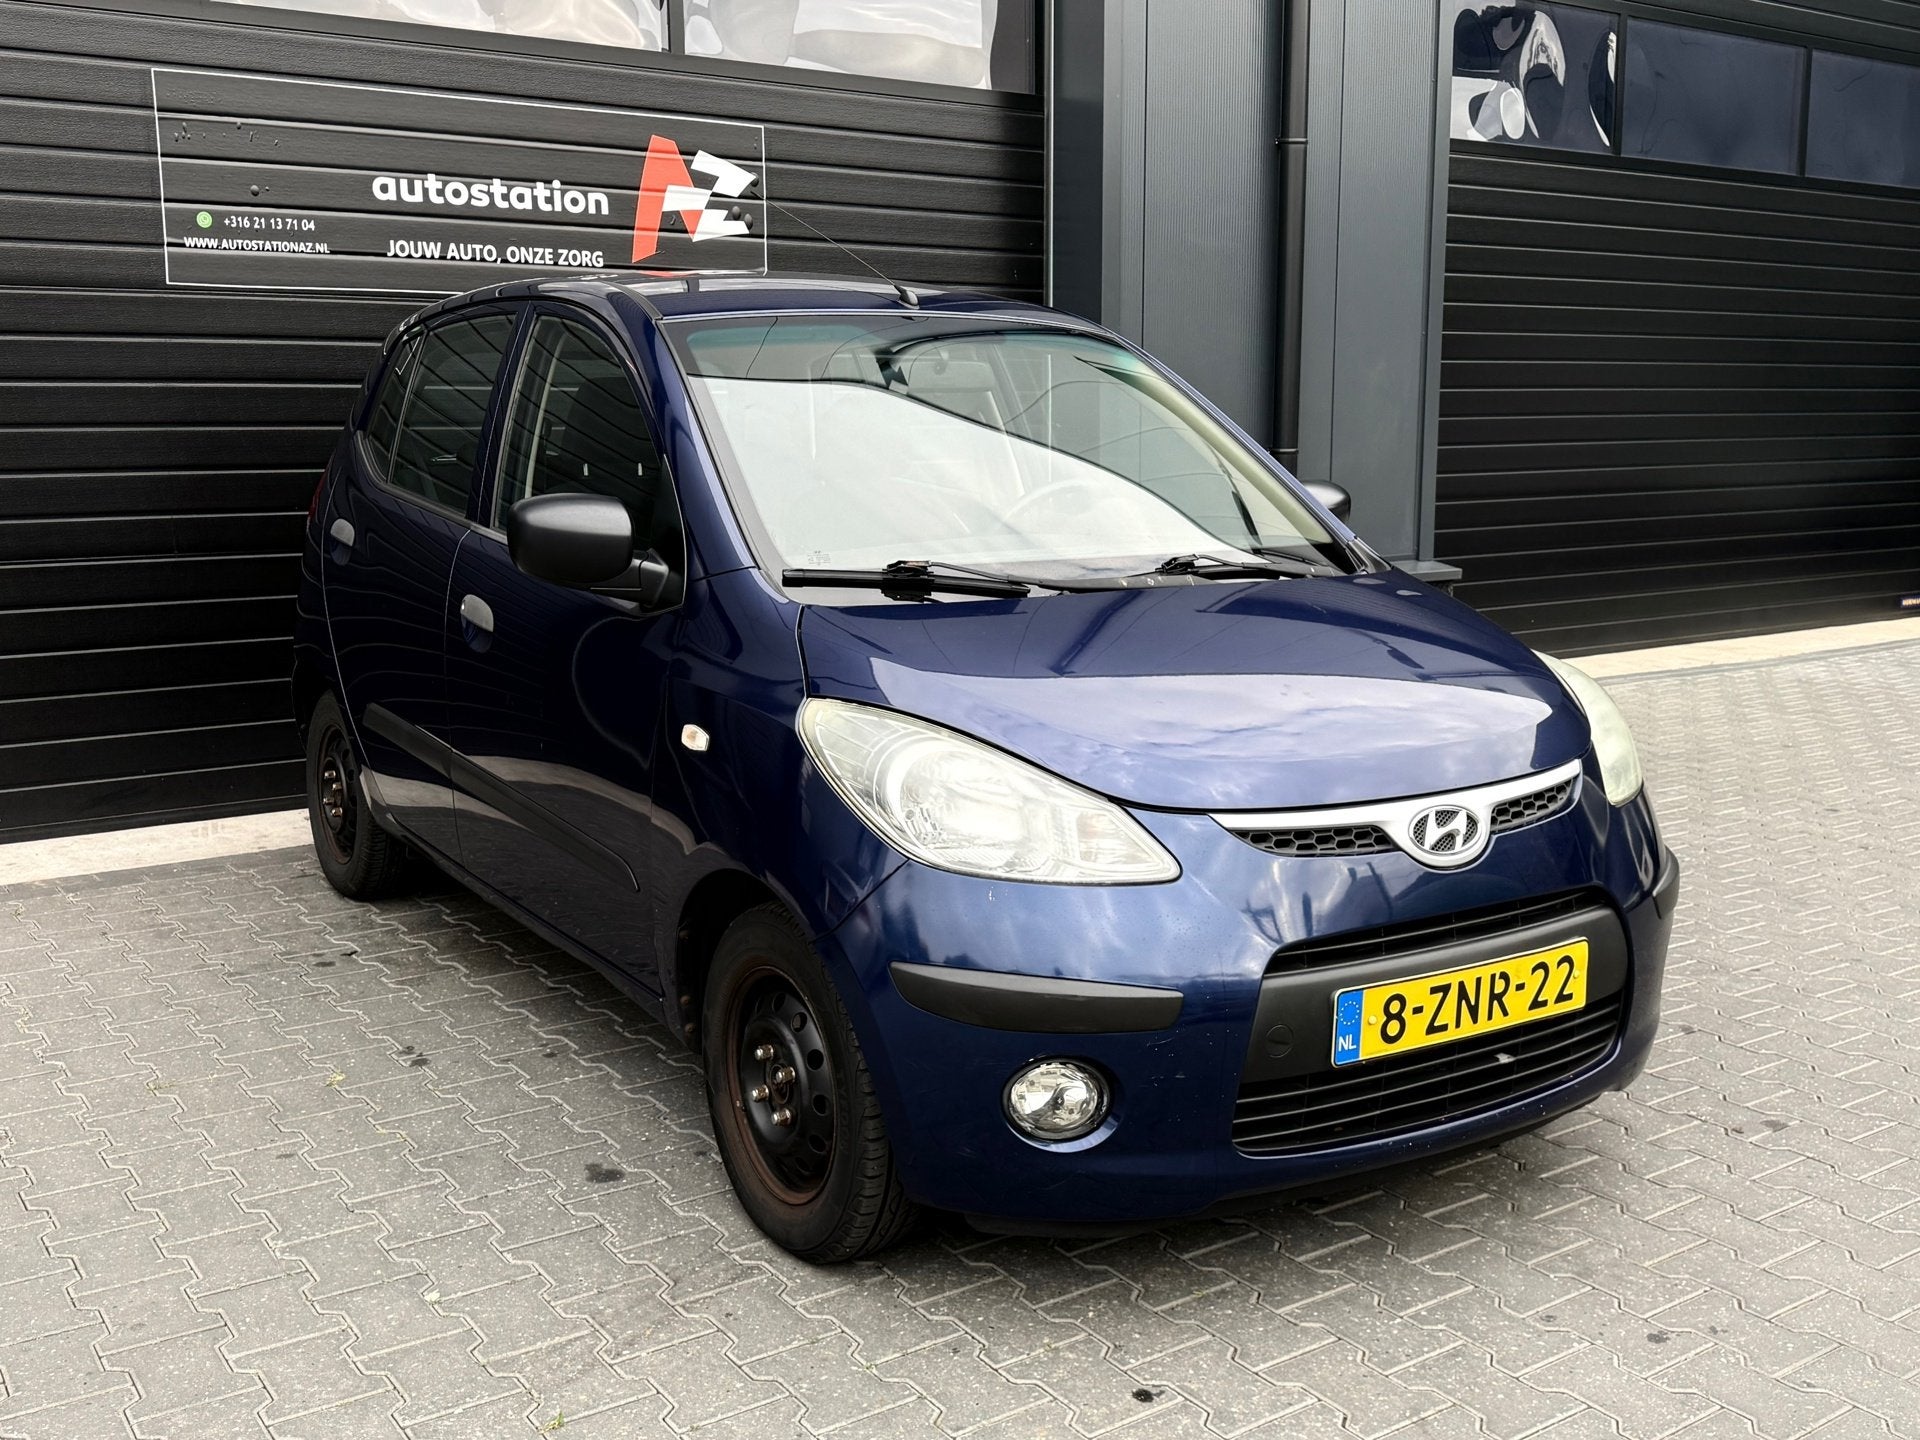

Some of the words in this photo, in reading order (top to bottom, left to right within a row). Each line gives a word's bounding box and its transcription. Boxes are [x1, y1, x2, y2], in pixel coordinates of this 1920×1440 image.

[372, 173, 609, 215] autostation
[223, 215, 250, 229] +316
[253, 217, 265, 229] 21
[270, 218, 282, 230] 13
[286, 219, 298, 231] 71
[302, 219, 315, 231] 04
[183, 236, 330, 254] WWW.AUTOSTATIONAZ.NL
[387, 239, 441, 259] JOUW
[446, 243, 502, 264] AUTO,
[506, 246, 553, 265] ONZE
[557, 249, 604, 268] ZORG
[1380, 955, 1575, 1045] 8-ZNR-22
[1338, 1033, 1357, 1052] NL
